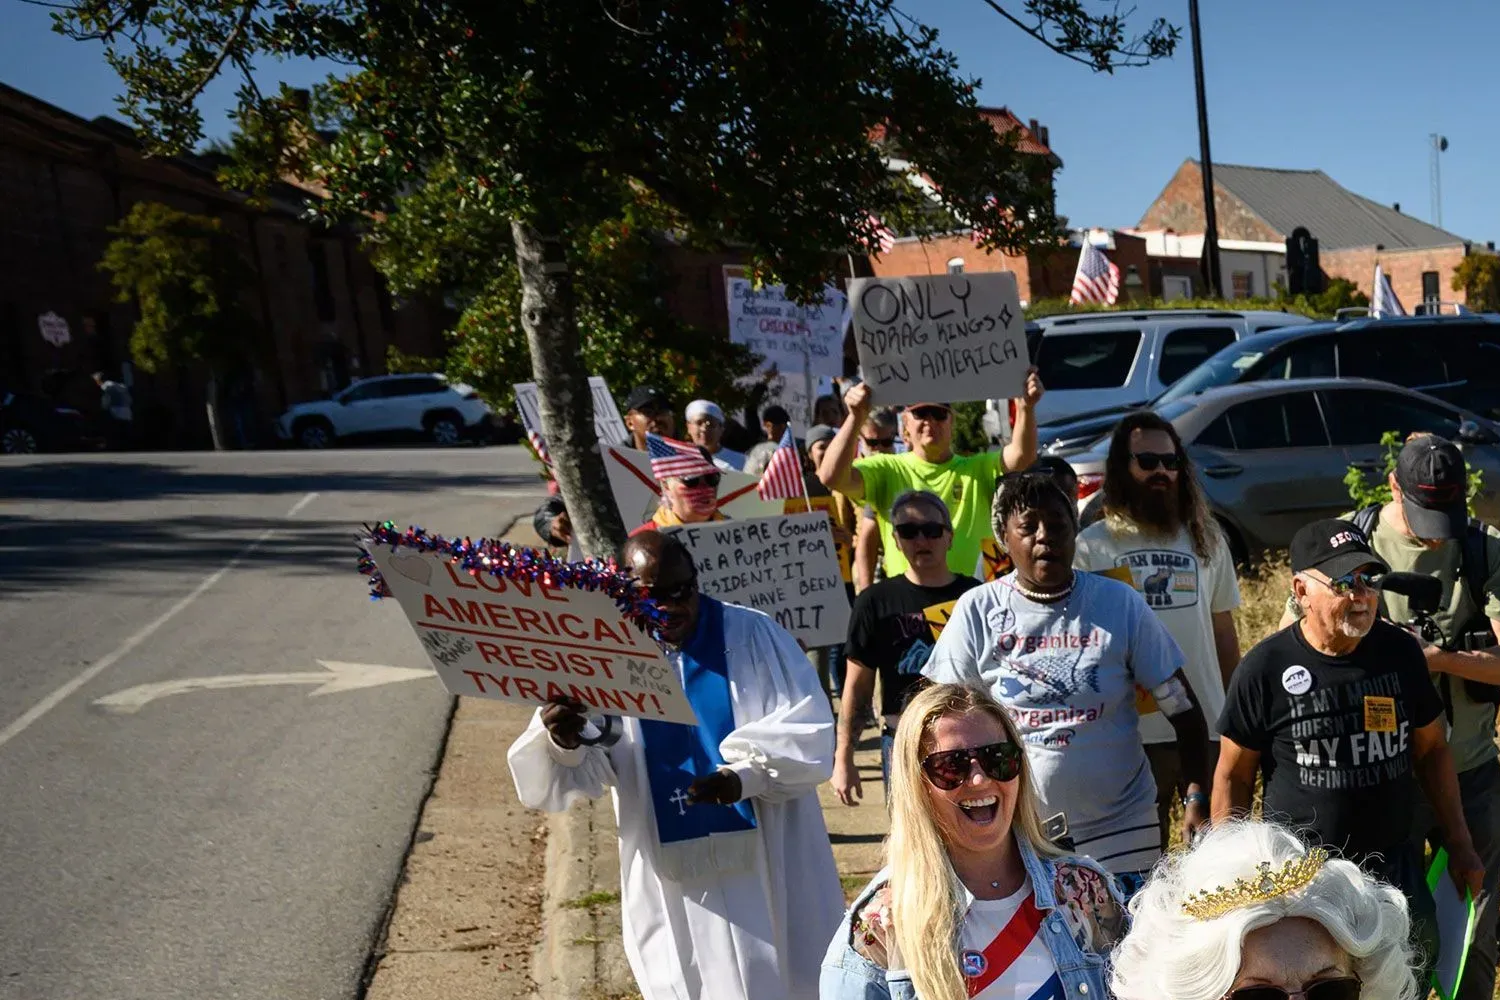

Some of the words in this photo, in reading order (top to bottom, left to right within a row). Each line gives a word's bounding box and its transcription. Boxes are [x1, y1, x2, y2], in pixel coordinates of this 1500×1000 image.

[862, 280, 971, 325] ONLY
[877, 322, 928, 355] DRAG
[938, 315, 995, 344] KINGS
[874, 361, 910, 385] IN
[920, 339, 1018, 380] AMERICA
[714, 522, 771, 546] WE'RE
[1330, 531, 1366, 548] SEOUL
[697, 559, 712, 574] VE
[718, 555, 730, 570] A
[799, 539, 829, 558] FOR
[702, 567, 776, 595] ESIDENT,
[782, 562, 805, 581] IT
[751, 586, 787, 609] HAVE
[799, 575, 837, 597] BEEN
[424, 594, 637, 646] AMERICA!
[1000, 629, 1101, 653] Organize!
[476, 640, 614, 680] RESIST
[463, 669, 665, 715] TYRANNY!
[1310, 686, 1341, 713] MY
[1008, 702, 1105, 728] Organiza!
[1294, 736, 1340, 768] MY
[1350, 720, 1410, 766] FACE
[1300, 765, 1381, 789] DEFINITELY
